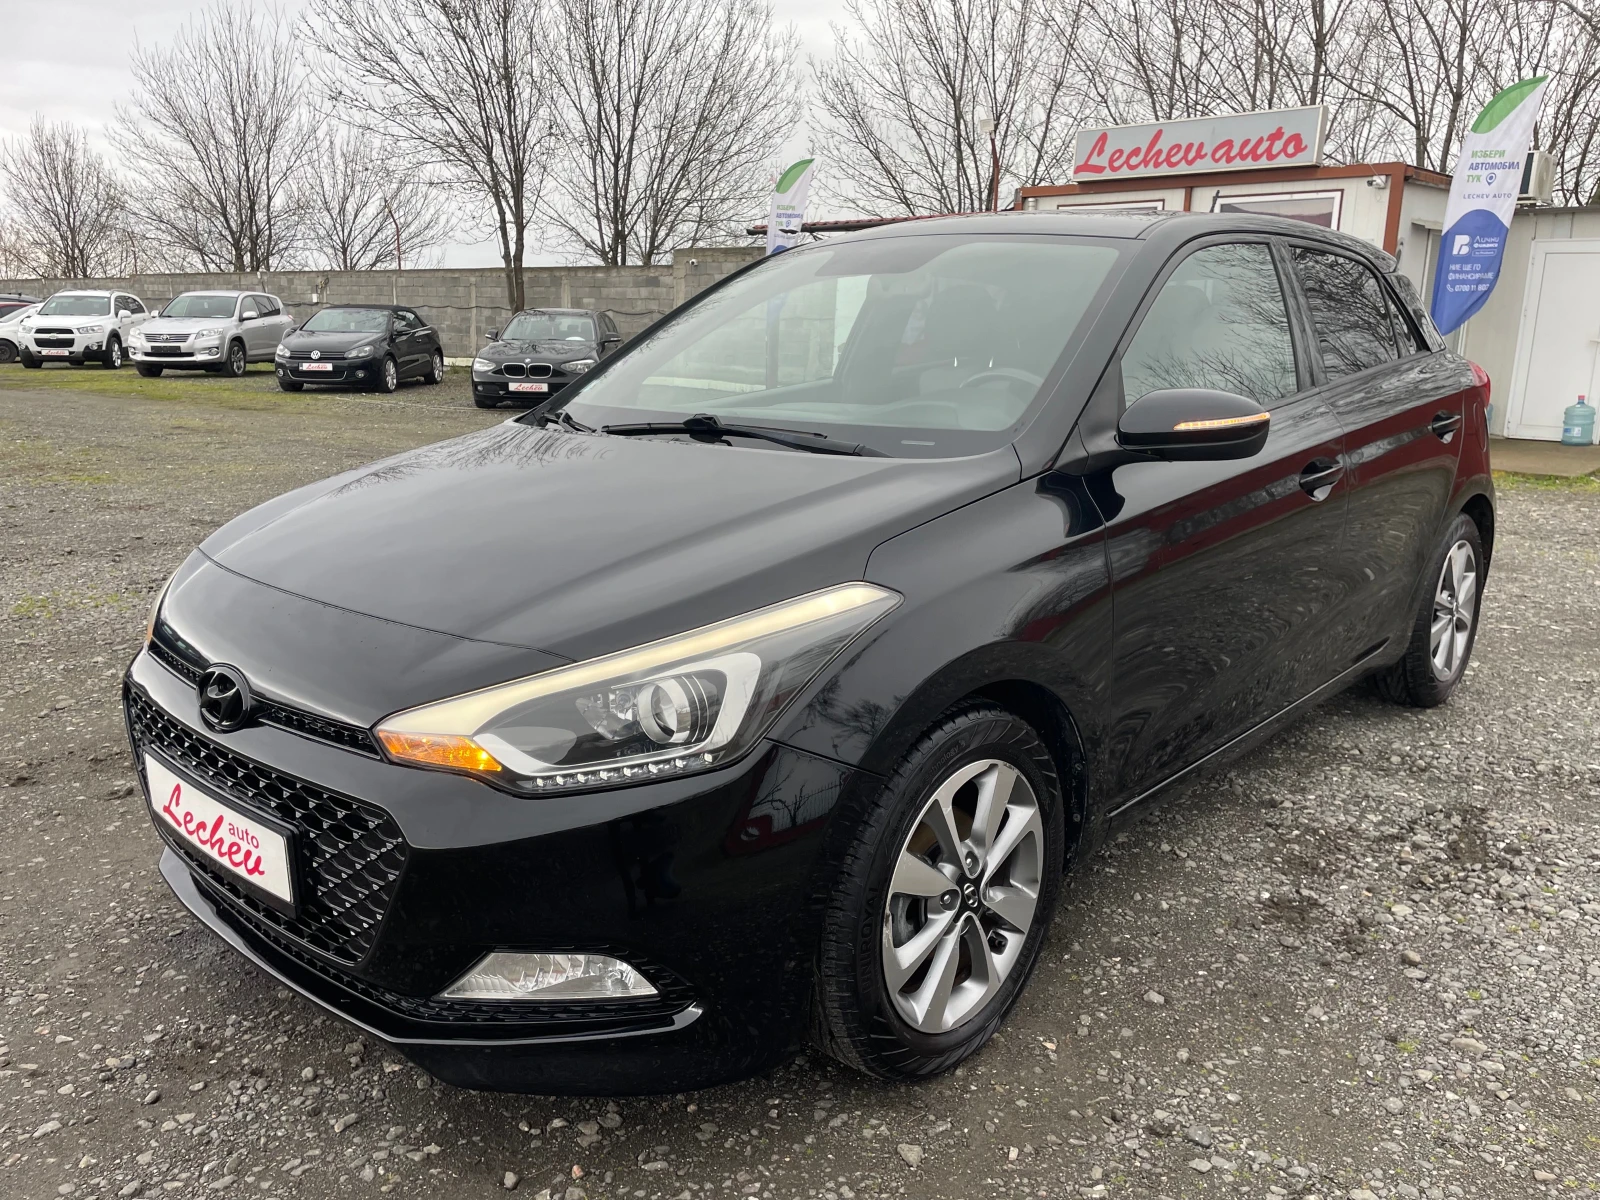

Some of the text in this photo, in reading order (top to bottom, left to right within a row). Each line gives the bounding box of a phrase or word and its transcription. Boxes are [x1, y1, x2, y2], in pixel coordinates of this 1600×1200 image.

[1073, 126, 1308, 175] Lechev auto
[1471, 150, 1506, 158] ИЗБЕРИ
[1468, 162, 1520, 171] АВТОМОБИЛ
[1466, 174, 1482, 183] ТУК
[163, 783, 265, 876] Lechev
[228, 822, 260, 849] auto
